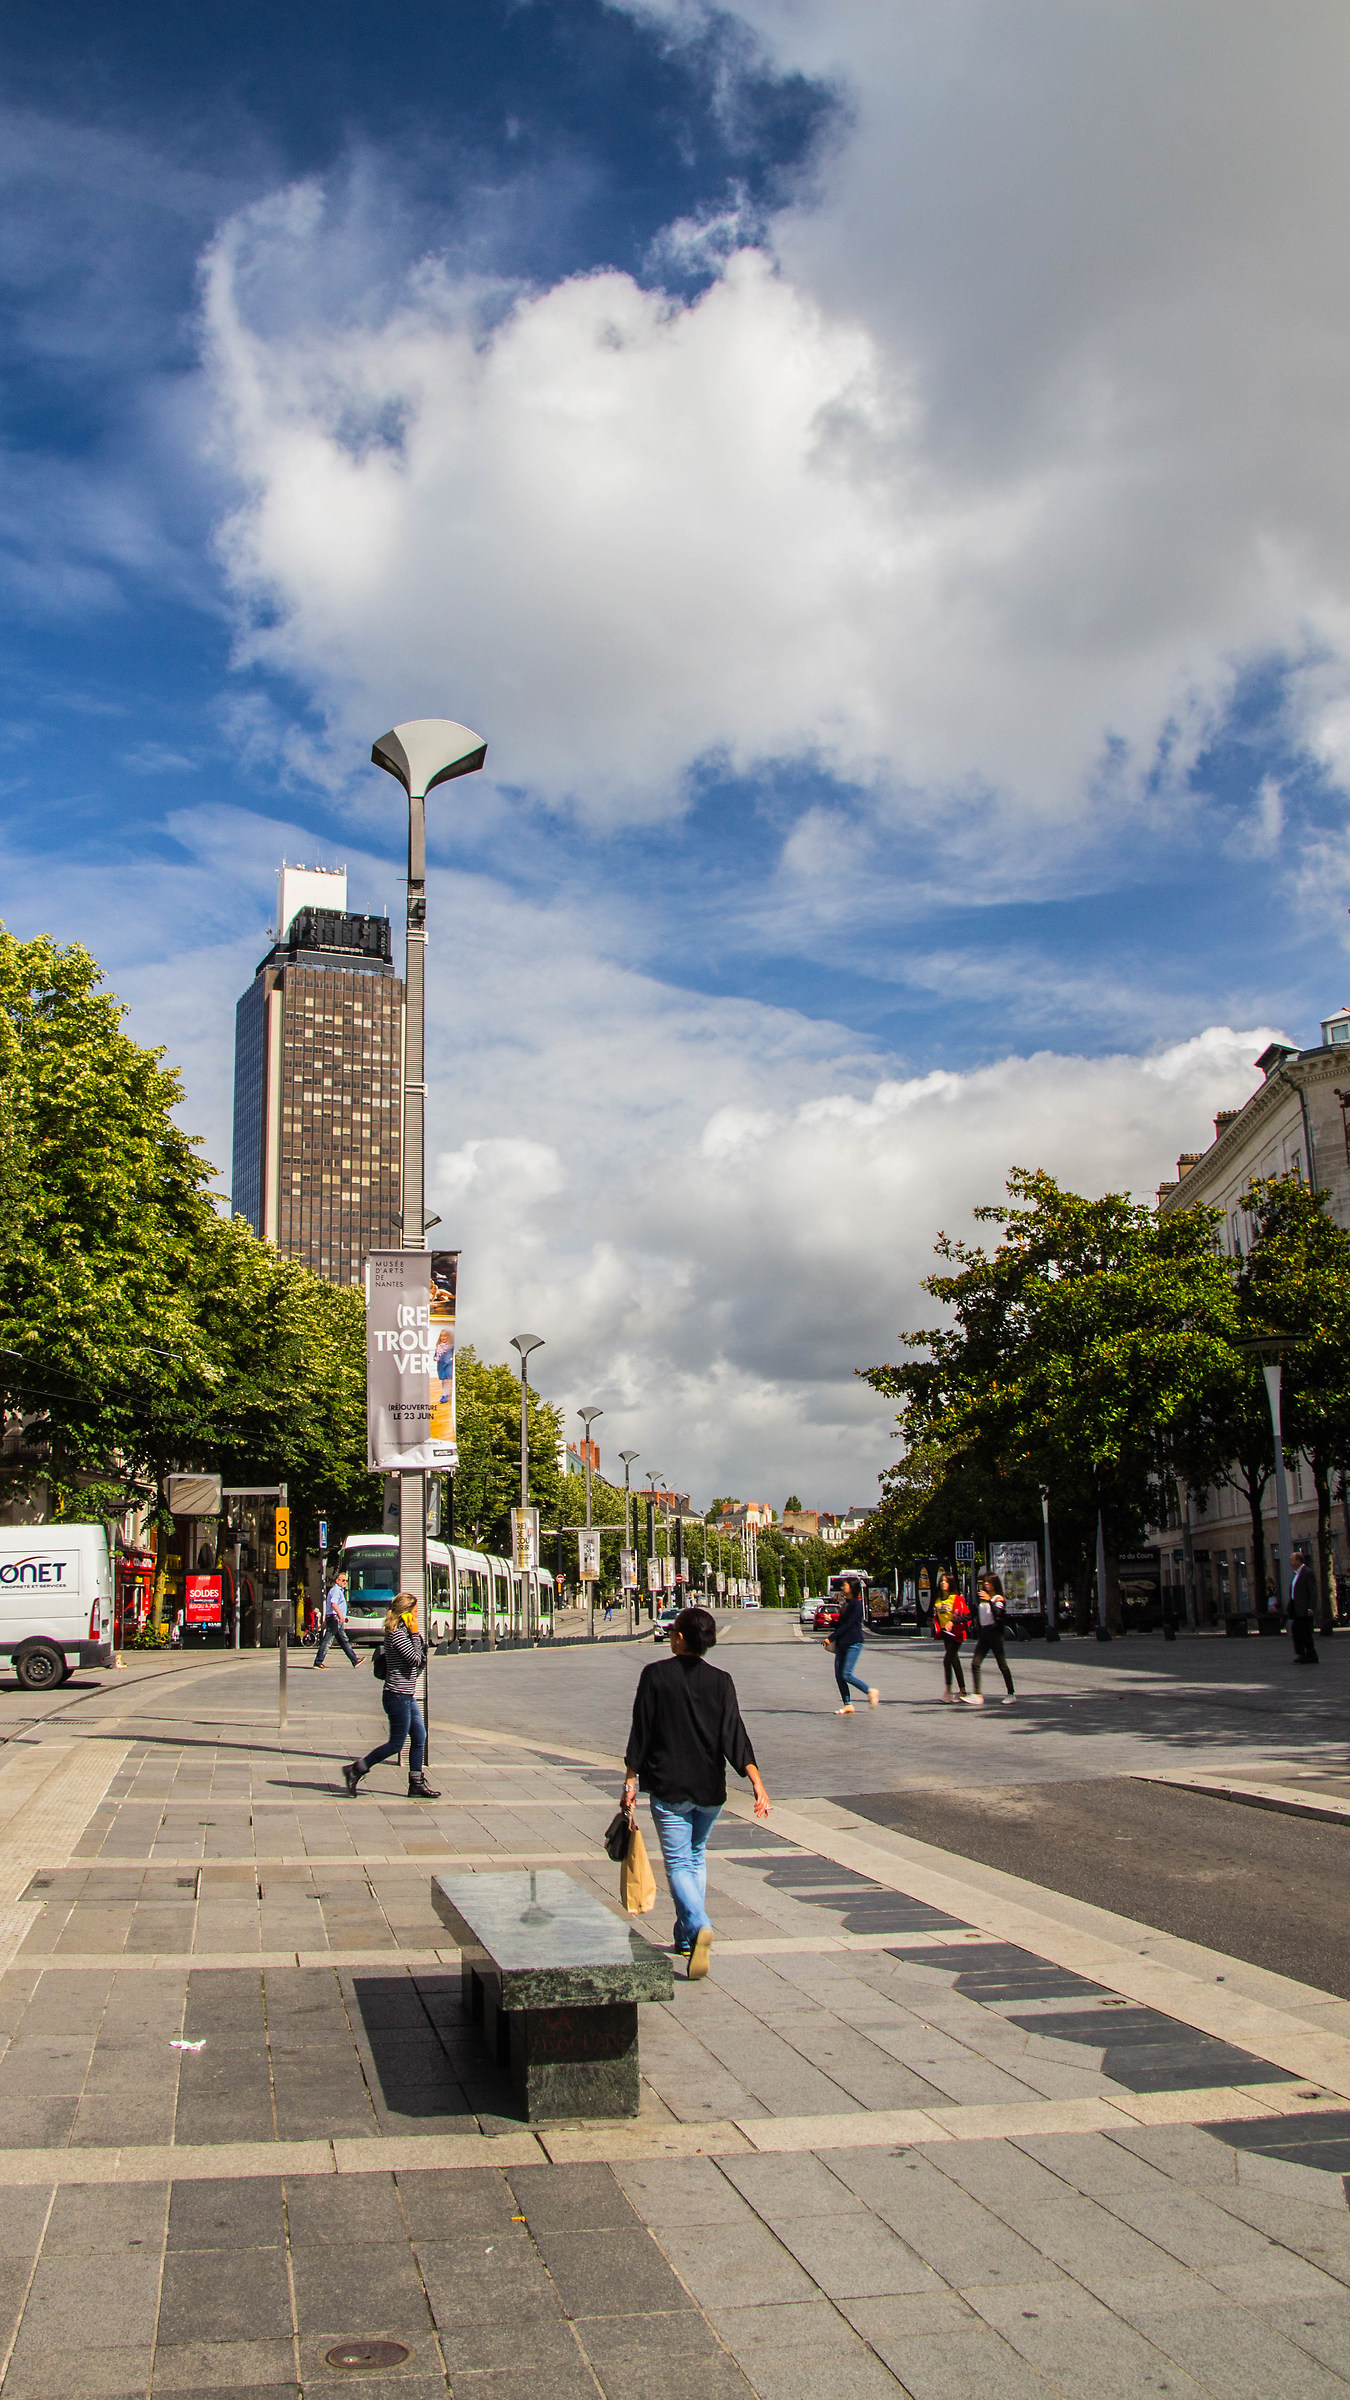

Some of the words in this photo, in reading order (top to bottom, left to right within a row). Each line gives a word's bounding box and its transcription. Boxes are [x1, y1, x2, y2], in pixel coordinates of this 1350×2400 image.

[375, 1259, 404, 1267] MUSÉE
[393, 1412, 402, 1420] LE
[404, 1412, 415, 1420] 23
[417, 1412, 434, 1420] JUIN
[189, 1589, 219, 1598] SOLDES
